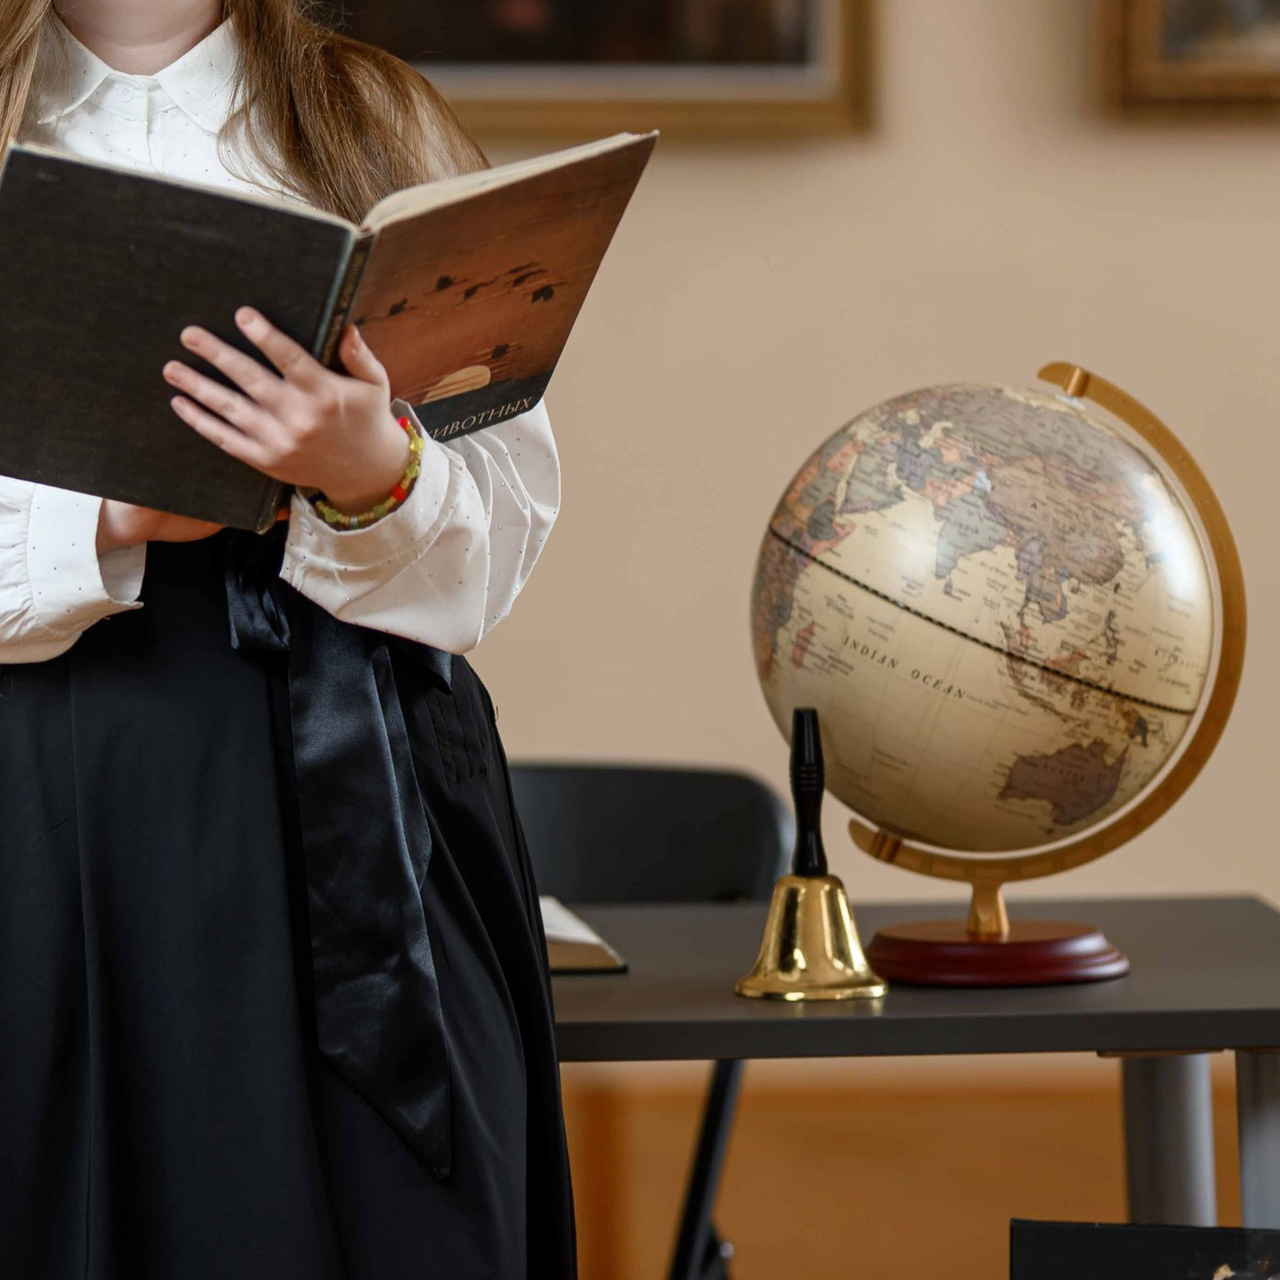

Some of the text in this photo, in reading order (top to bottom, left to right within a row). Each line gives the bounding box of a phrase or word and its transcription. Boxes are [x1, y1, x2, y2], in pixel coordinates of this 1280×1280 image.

[429, 397, 532, 440] ИВОТНЫХ
[843, 636, 899, 669] INDIAN
[910, 668, 966, 699] OCEAN
